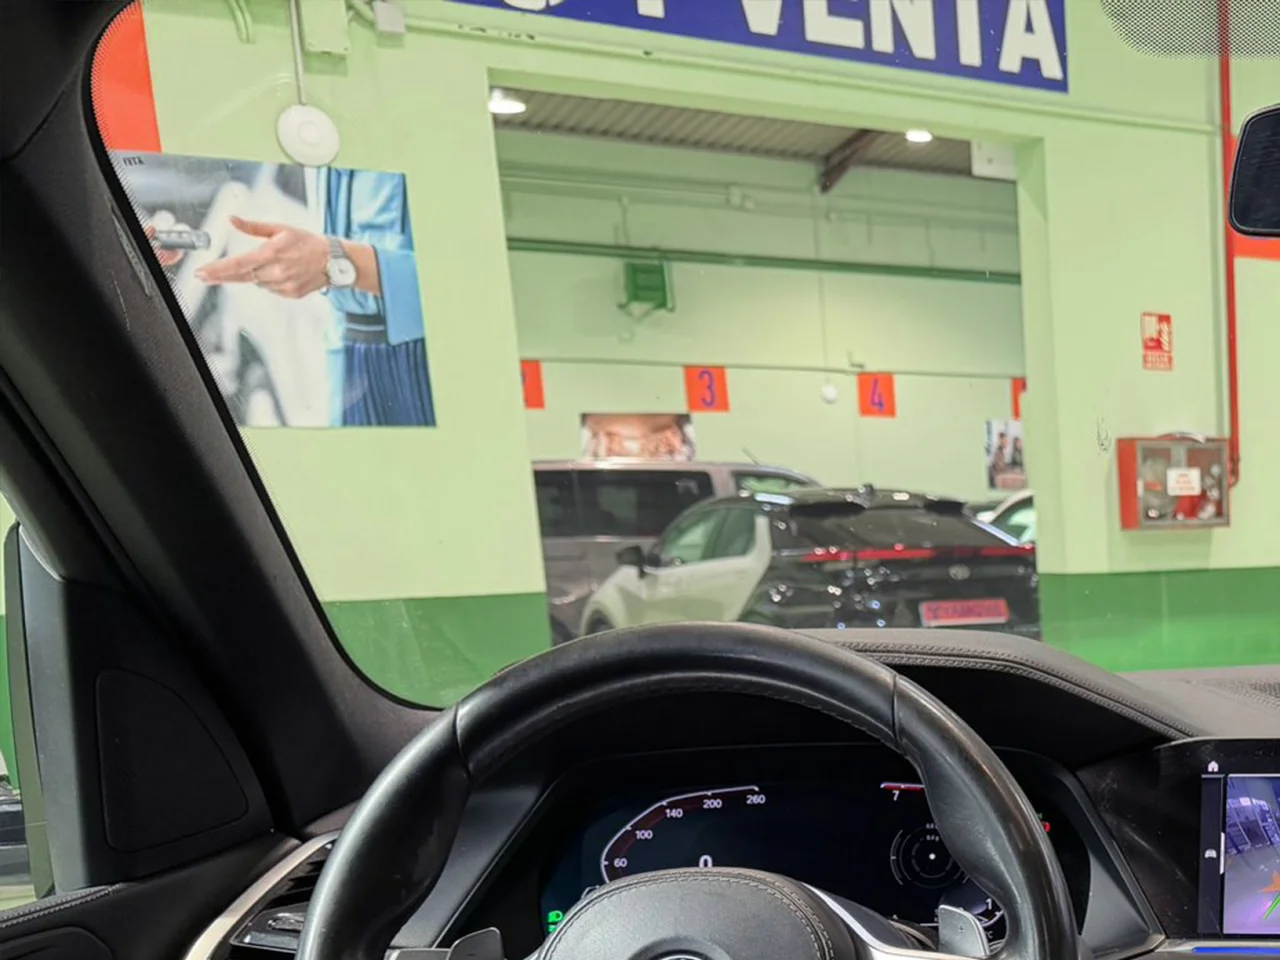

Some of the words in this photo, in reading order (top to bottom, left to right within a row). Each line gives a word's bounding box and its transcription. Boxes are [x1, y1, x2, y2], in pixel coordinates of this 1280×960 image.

[699, 369, 717, 407] 3
[869, 378, 884, 412] 4
[746, 794, 766, 805] 260
[892, 790, 900, 801] 7
[702, 799, 723, 809] 200
[665, 808, 683, 818] 140
[635, 829, 653, 839] 100
[613, 858, 628, 868] 60
